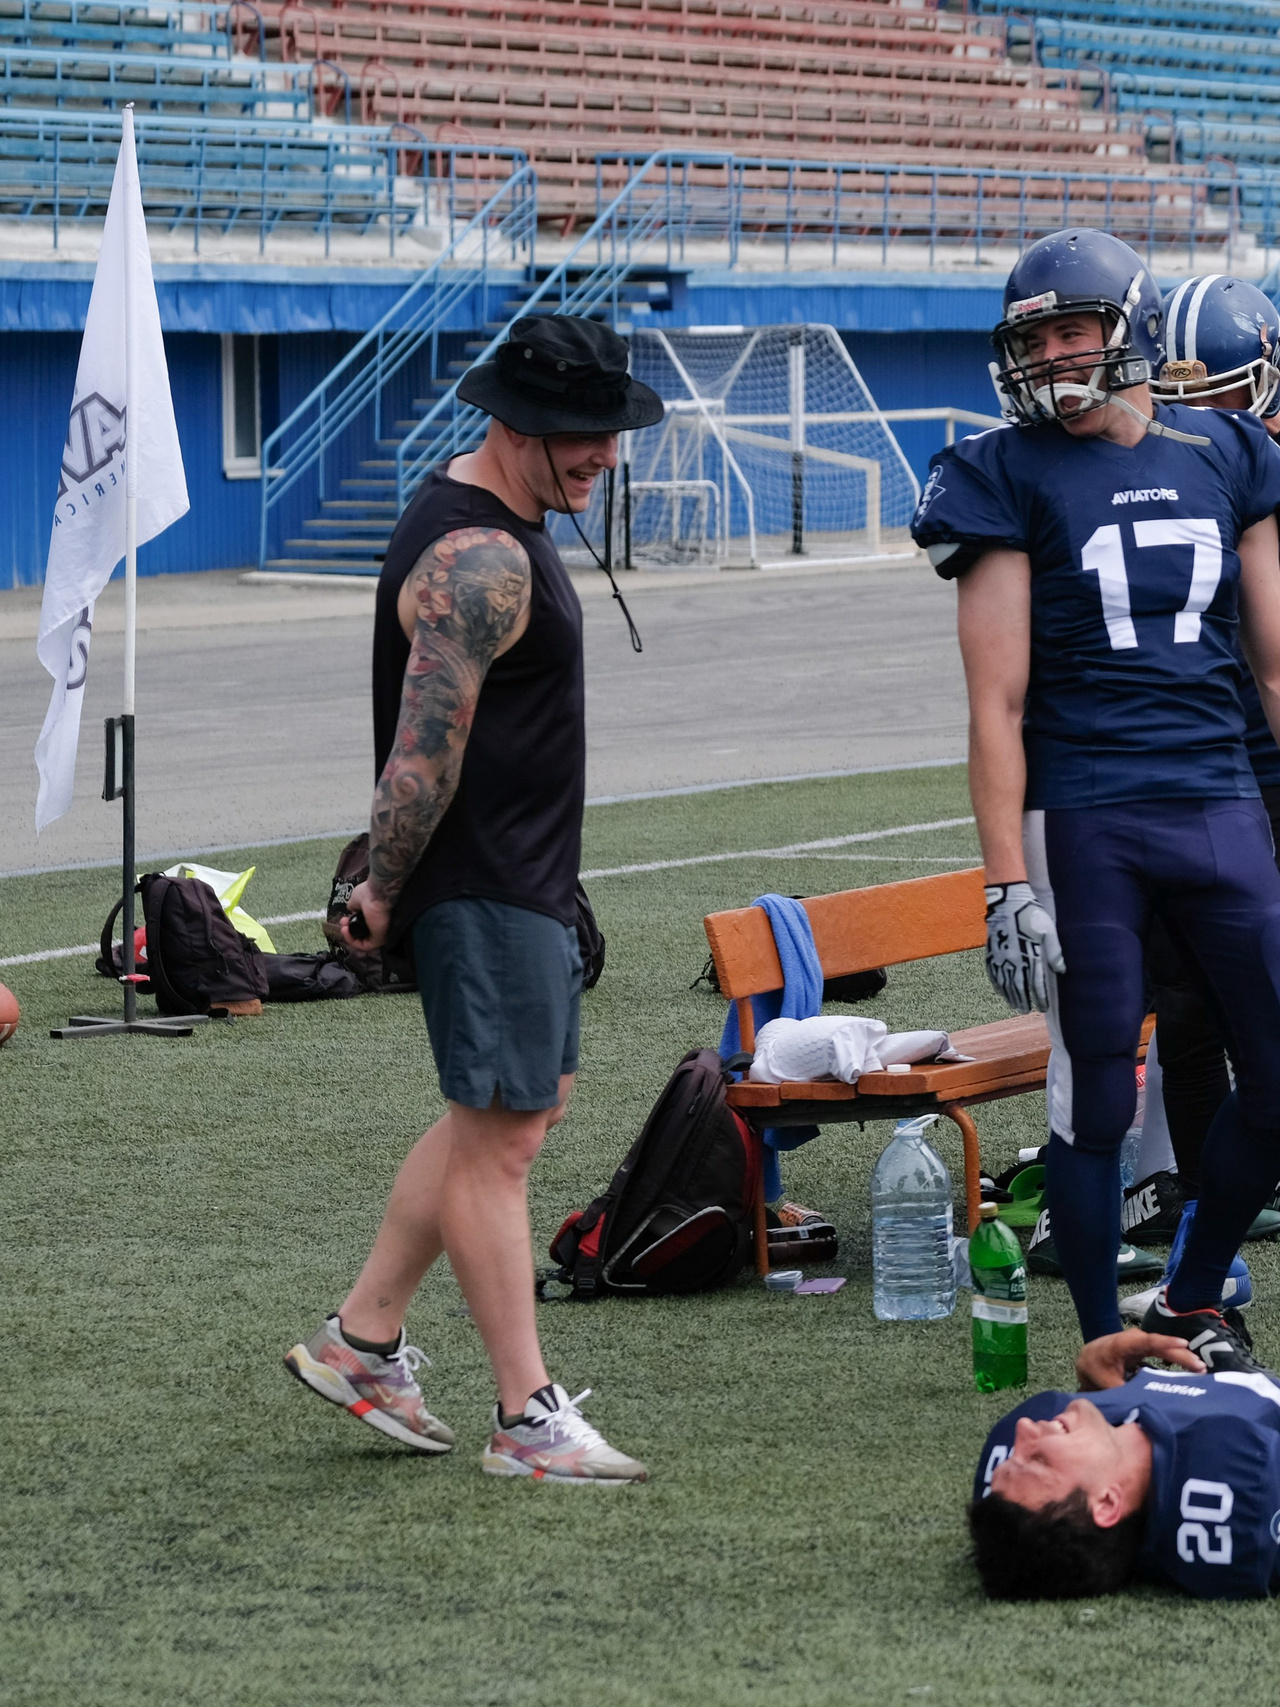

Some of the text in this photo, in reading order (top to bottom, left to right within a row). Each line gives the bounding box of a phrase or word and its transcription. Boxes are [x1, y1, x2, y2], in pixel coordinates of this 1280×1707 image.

[1111, 488, 1179, 505] AVIATORS
[1081, 518, 1223, 650] 17
[1177, 1478, 1234, 1565] 20
